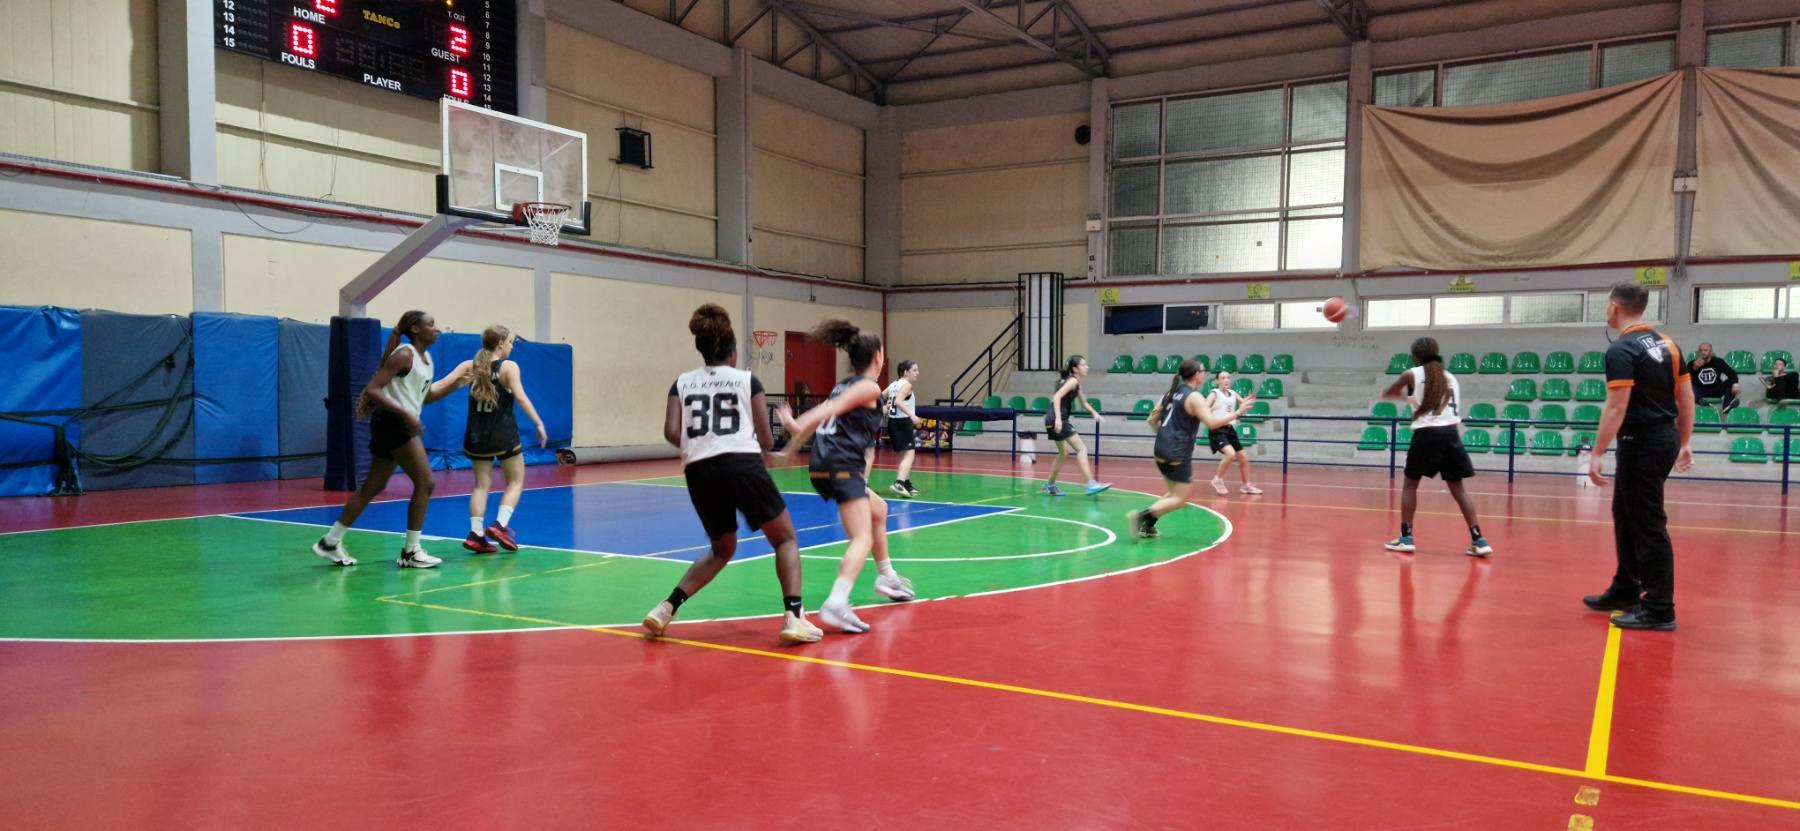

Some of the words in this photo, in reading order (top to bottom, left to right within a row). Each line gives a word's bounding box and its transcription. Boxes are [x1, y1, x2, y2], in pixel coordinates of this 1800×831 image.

[223, 0, 235, 11] 12
[223, 12, 235, 23] 13
[293, 6, 326, 24] HOME
[453, 13, 466, 22] OUT
[485, 11, 490, 19] 6
[223, 25, 236, 35] 14
[485, 21, 490, 29] 7
[292, 24, 314, 55] 0
[450, 26, 467, 53] 2
[485, 31, 490, 40] 8
[223, 37, 236, 48] 15
[485, 41, 491, 50] 9
[431, 47, 460, 63] GUEST
[482, 52, 491, 61] 10
[281, 52, 316, 70] FOULS
[482, 63, 491, 72] 11
[363, 73, 402, 91] PLAYER
[451, 69, 468, 96] 0
[483, 73, 492, 82] 12
[483, 83, 492, 92] 13
[483, 94, 492, 103] 14
[684, 392, 740, 438] 36
